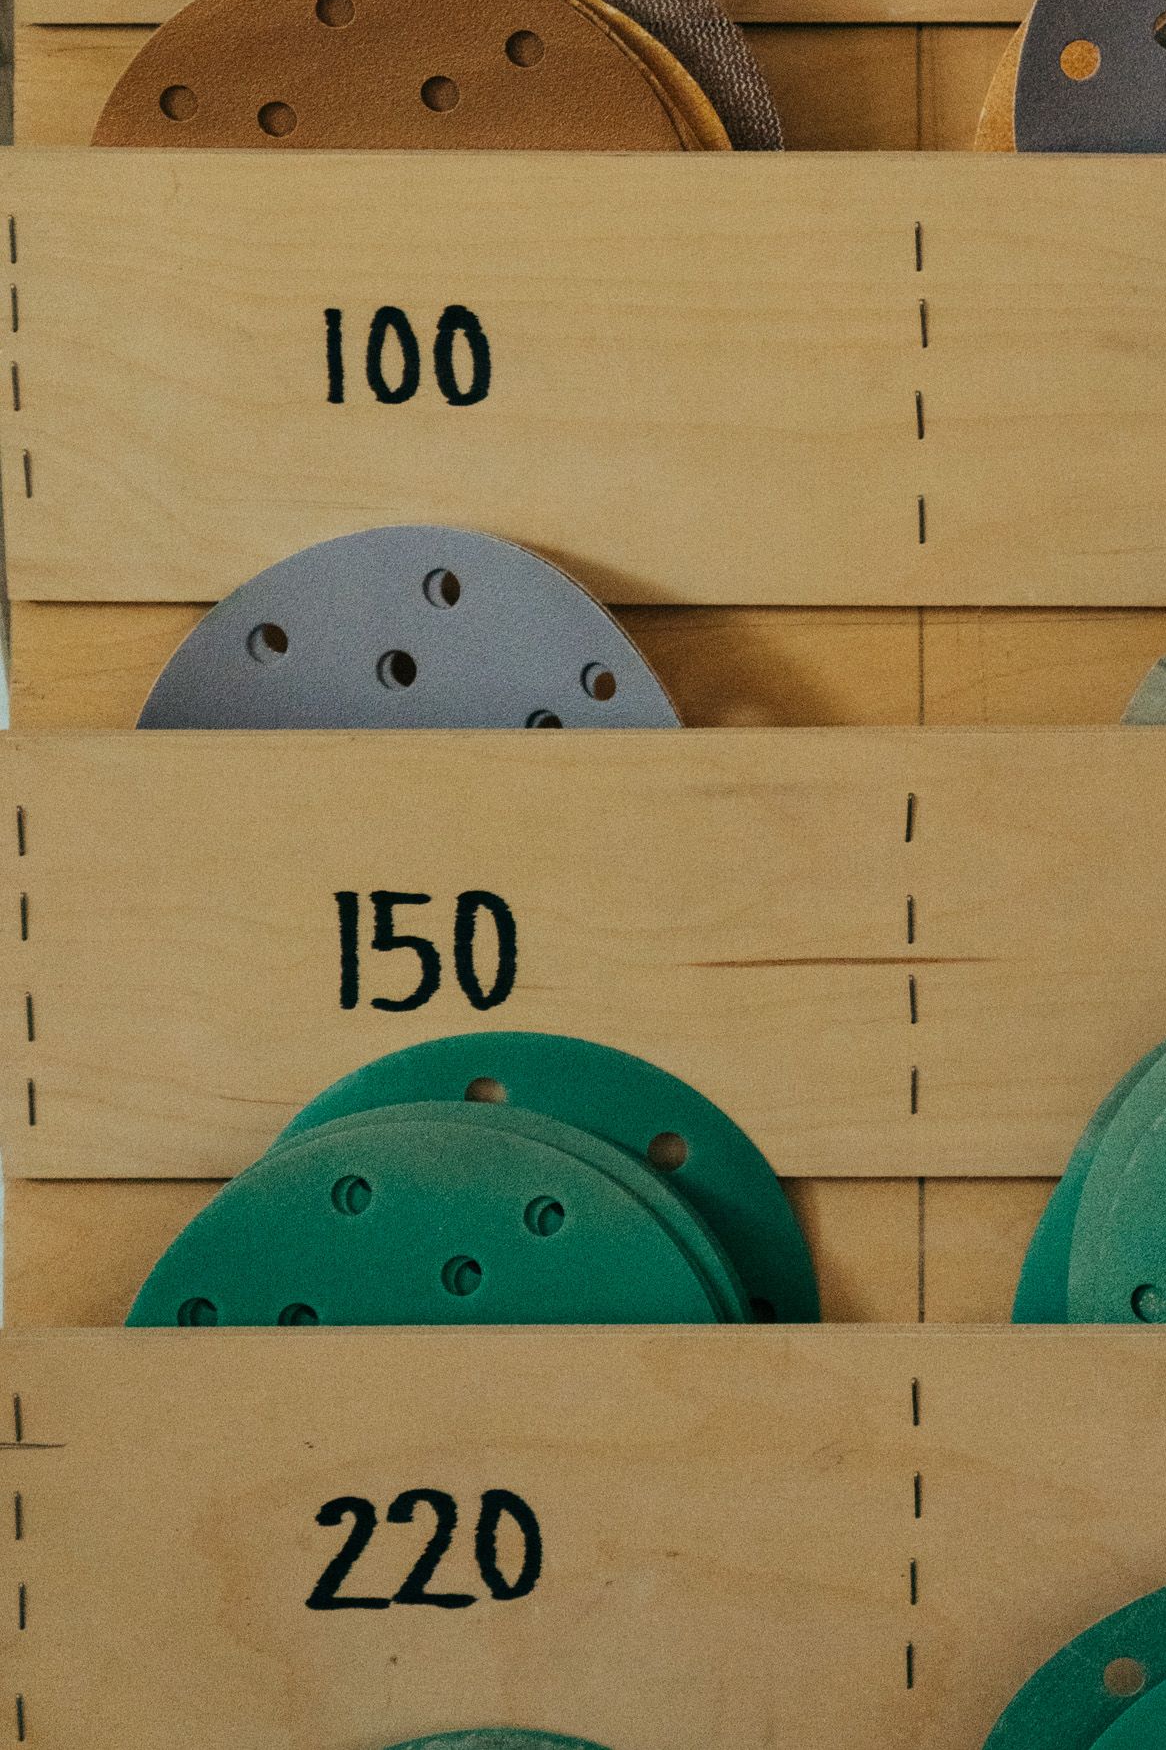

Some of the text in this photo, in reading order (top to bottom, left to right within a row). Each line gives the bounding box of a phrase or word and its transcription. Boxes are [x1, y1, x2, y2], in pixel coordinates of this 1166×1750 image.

[324, 304, 492, 407] 100
[335, 890, 518, 1012] 150
[305, 1488, 544, 1611] 220
